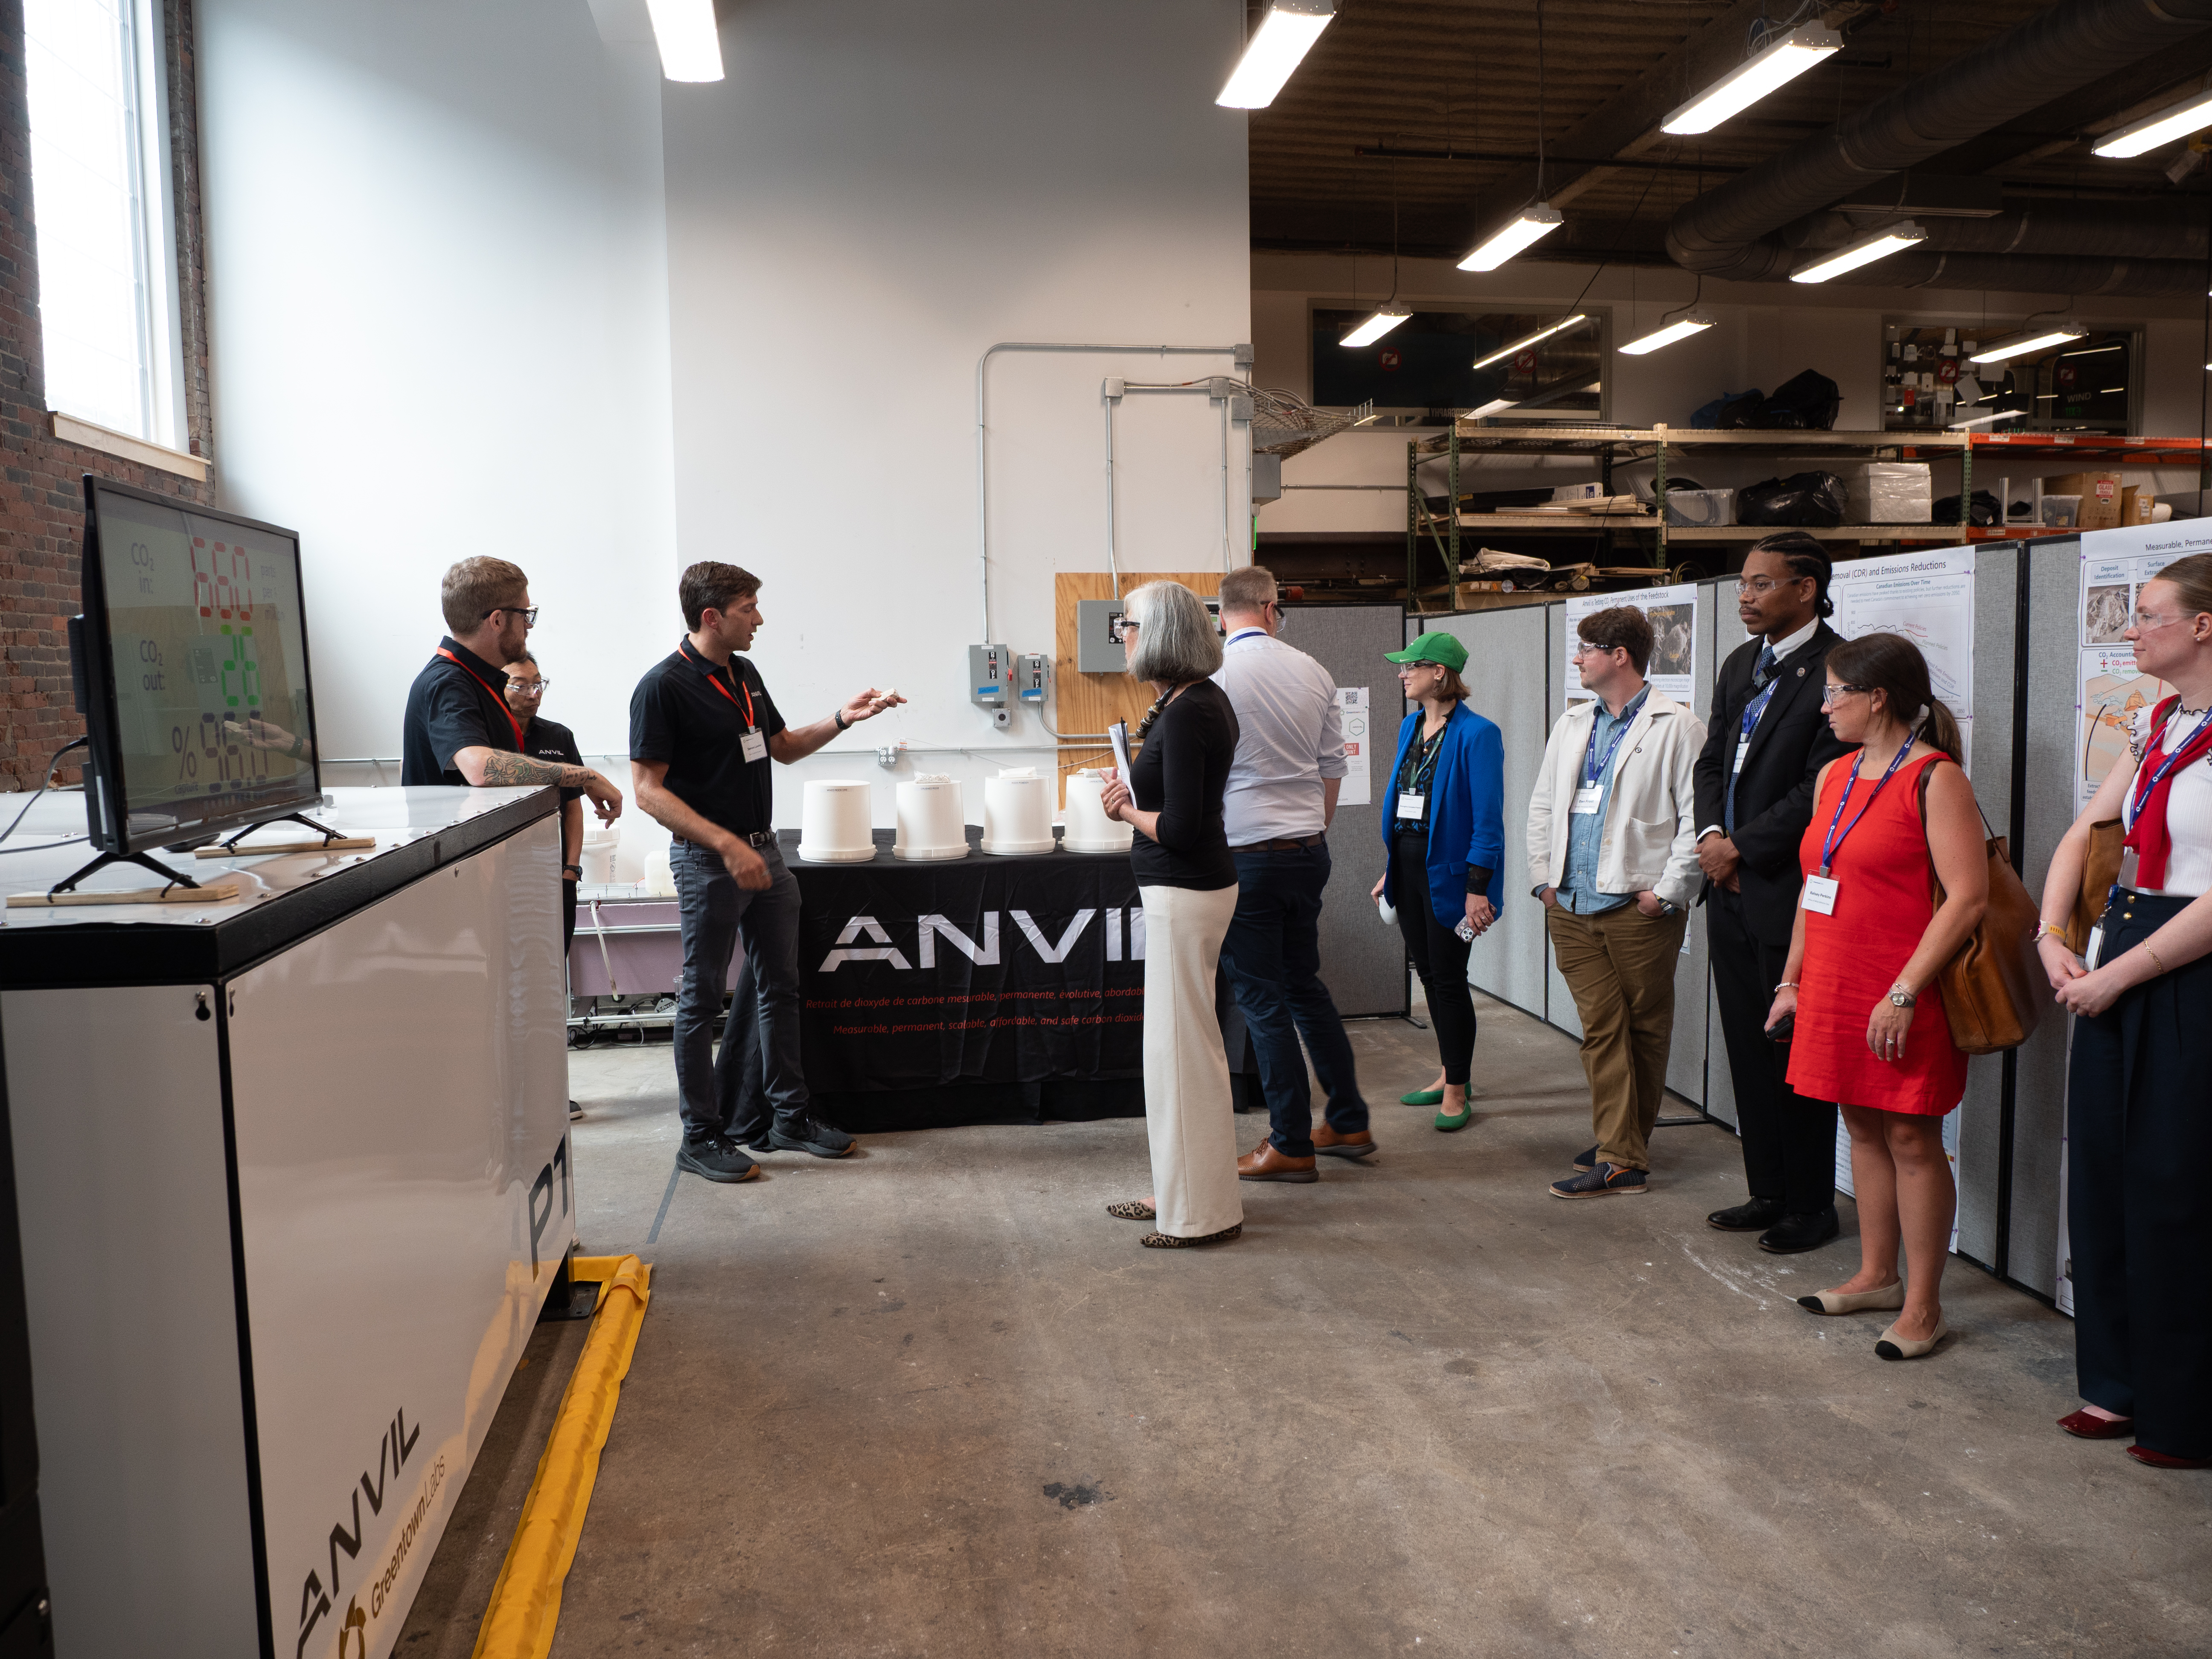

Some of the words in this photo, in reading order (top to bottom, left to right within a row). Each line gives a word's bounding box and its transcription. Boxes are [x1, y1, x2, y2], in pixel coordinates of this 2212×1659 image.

[2067, 392, 2091, 403] WIND
[2145, 541, 2183, 551] Measurable,
[1851, 569, 1868, 579] (CDR)
[1869, 567, 1880, 576] and
[1881, 565, 1909, 575] Emissions
[1910, 561, 1947, 572] Reductions
[1594, 599, 1604, 607] Testing
[1610, 596, 1627, 604] Permanent
[1648, 590, 1669, 600] Feedstock
[1921, 639, 1936, 648] Planned
[220, 624, 262, 707] 26
[806, 998, 838, 1009] Retrait
[840, 998, 852, 1008] de
[854, 997, 890, 1009] dioxyde
[893, 996, 904, 1006] de
[907, 995, 945, 1006] carbone
[947, 991, 997, 1004] mesurable,
[999, 990, 1056, 1002] permanente,
[1059, 989, 1102, 999] évolutive,
[833, 1024, 889, 1035] Measurable,
[892, 1022, 946, 1035] permanent,
[948, 1019, 987, 1030] scalable,
[990, 1016, 1037, 1028] affordable,
[1040, 1016, 1058, 1026] and
[1060, 1015, 1079, 1027] safe
[1081, 1014, 1112, 1024] carbon
[297, 1406, 420, 1659] ANVIL
